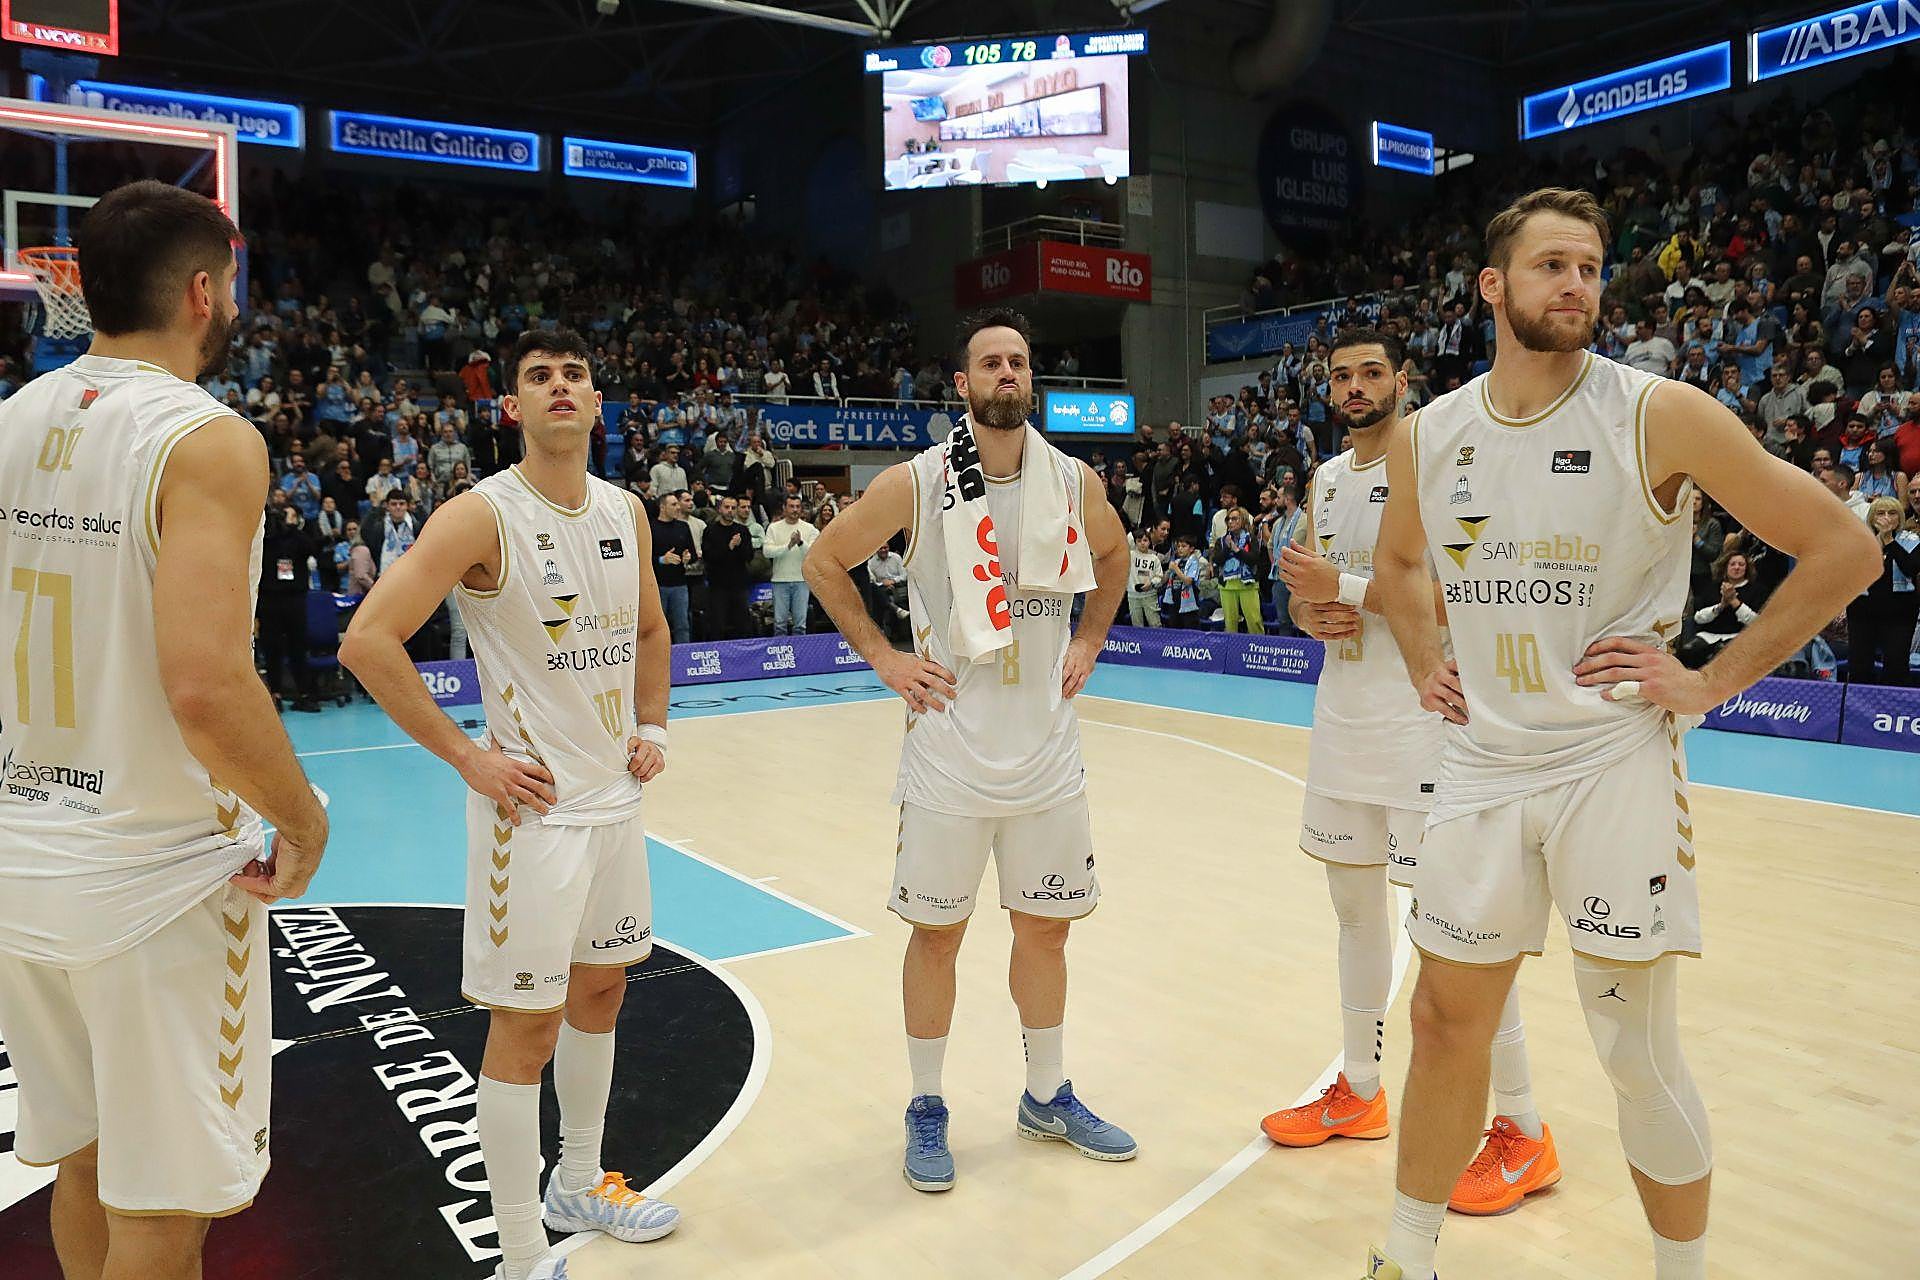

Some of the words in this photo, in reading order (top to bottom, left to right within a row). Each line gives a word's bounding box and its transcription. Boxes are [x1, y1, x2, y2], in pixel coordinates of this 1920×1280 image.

[964, 43, 1001, 64] 105
[1011, 41, 1037, 61] 78
[1583, 69, 1687, 116] CANDELAS
[342, 121, 427, 153] Estrella
[430, 131, 504, 161] Galicia
[836, 410, 910, 421] FERRETERIA
[828, 423, 917, 442] ELIAS
[1534, 561, 1598, 573] INMOBILIARIA
[12, 566, 76, 729] 77
[691, 650, 720, 660] GRUPO
[767, 645, 794, 655] GRUPO
[1248, 642, 1304, 657] Transportes
[702, 658, 721, 667] LUIS
[762, 661, 796, 671] IGLESIAS
[777, 653, 795, 662] LUIS
[1282, 657, 1310, 670] HIJOS
[1496, 633, 1548, 694] 40
[687, 666, 722, 677] IGLESIAS
[7, 760, 104, 796] cajarural
[7, 783, 51, 802] Burgos
[916, 893, 948, 904] CASTILLA
[1021, 888, 1086, 901] LEXUS
[1425, 912, 1462, 935] CASTILLA
[1466, 929, 1473, 939] Y
[1568, 914, 1642, 939] LEXUS
[592, 926, 651, 949] LEXUS
[272, 906, 407, 1014] NÚÑEZ
[358, 1006, 436, 1051] DE
